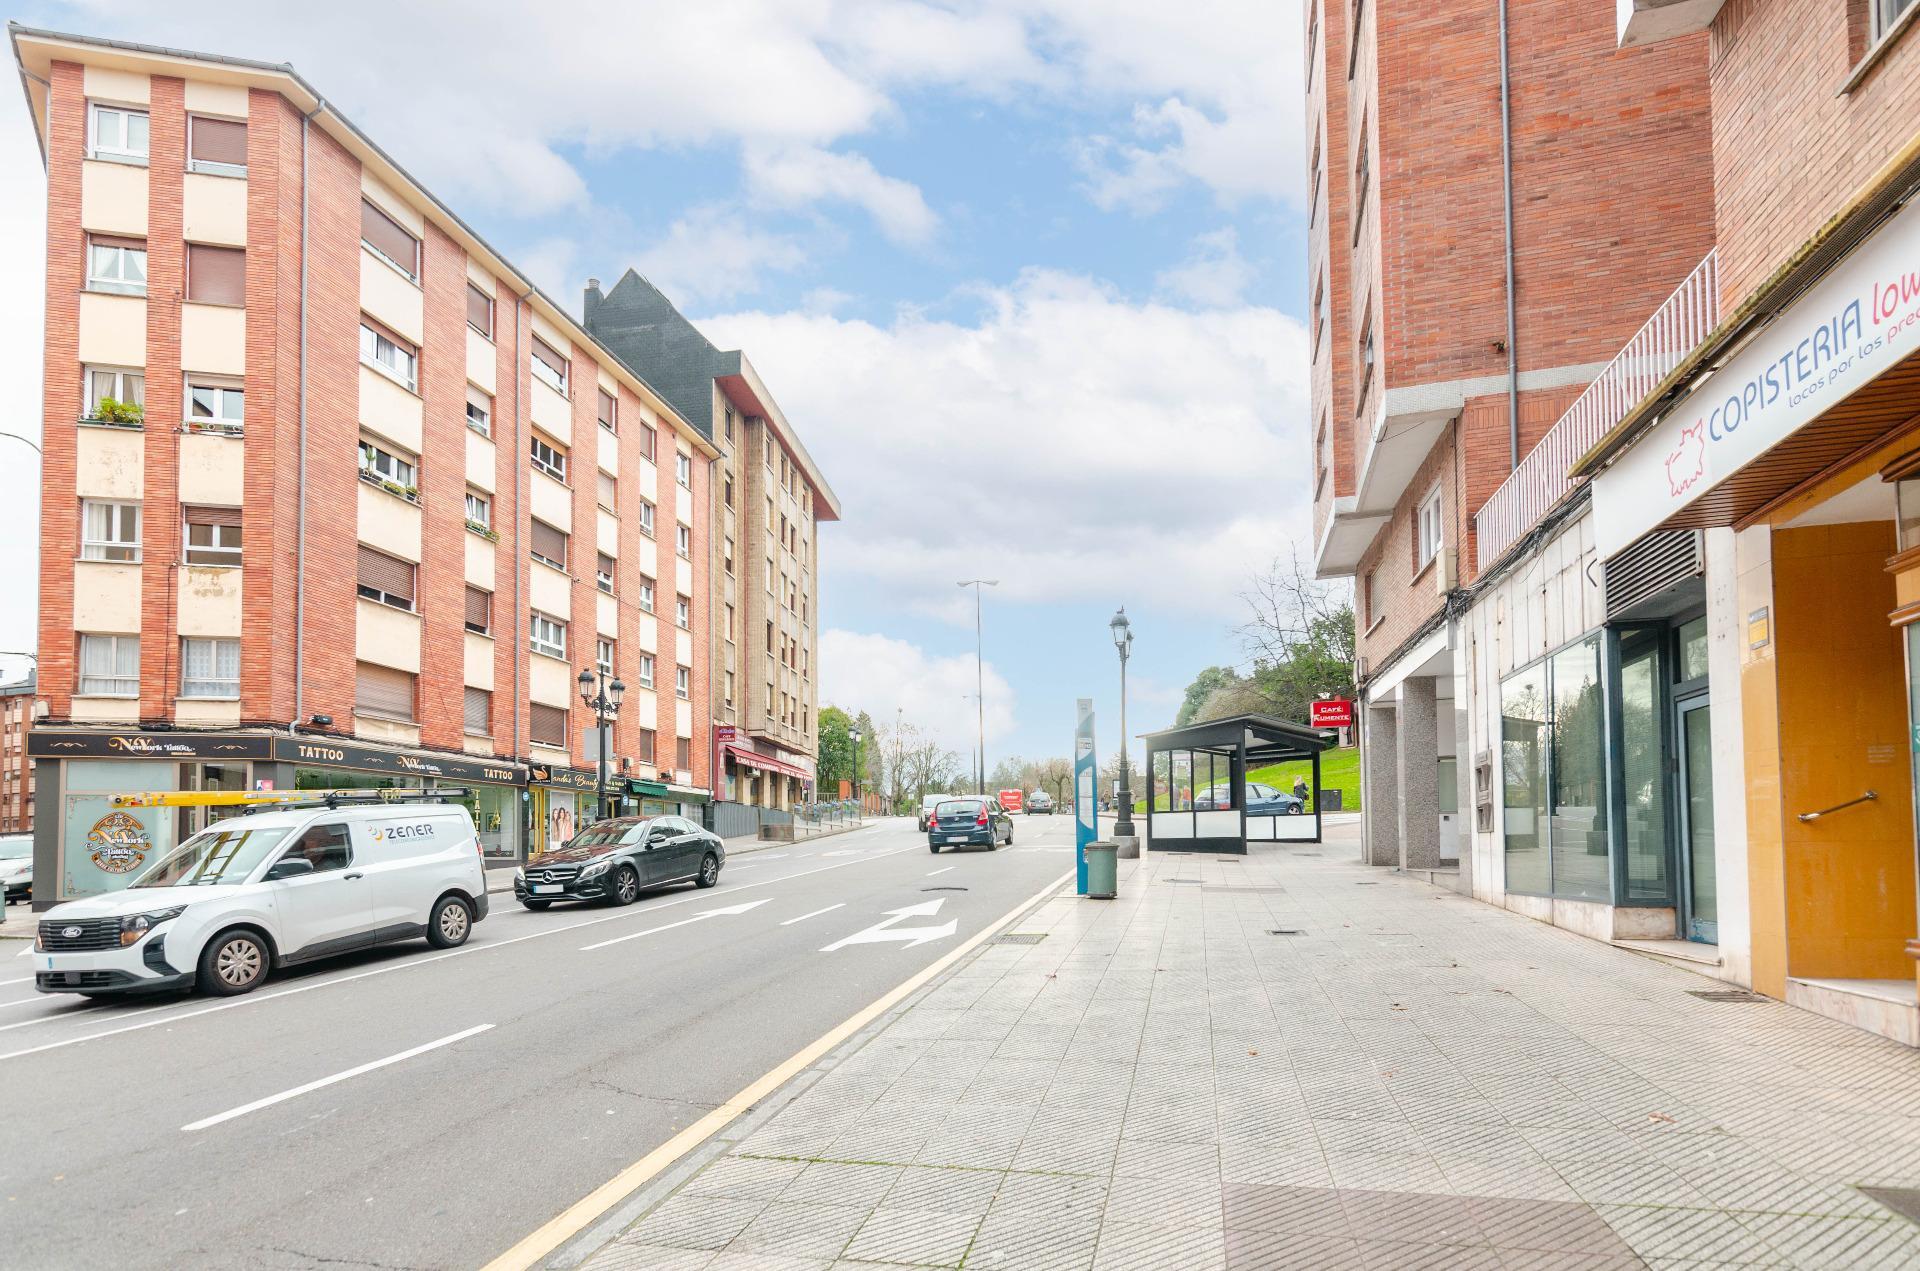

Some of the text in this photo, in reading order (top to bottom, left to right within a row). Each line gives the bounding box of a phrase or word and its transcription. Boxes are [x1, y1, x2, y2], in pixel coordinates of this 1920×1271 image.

[1709, 298, 1862, 441] COPISTERIA
[1789, 377, 1825, 408] locos
[1828, 355, 1855, 385] por
[1858, 336, 1882, 359] los
[298, 745, 344, 761] TATTOO
[483, 768, 513, 781] TATTOO
[385, 824, 433, 839] ZENER
